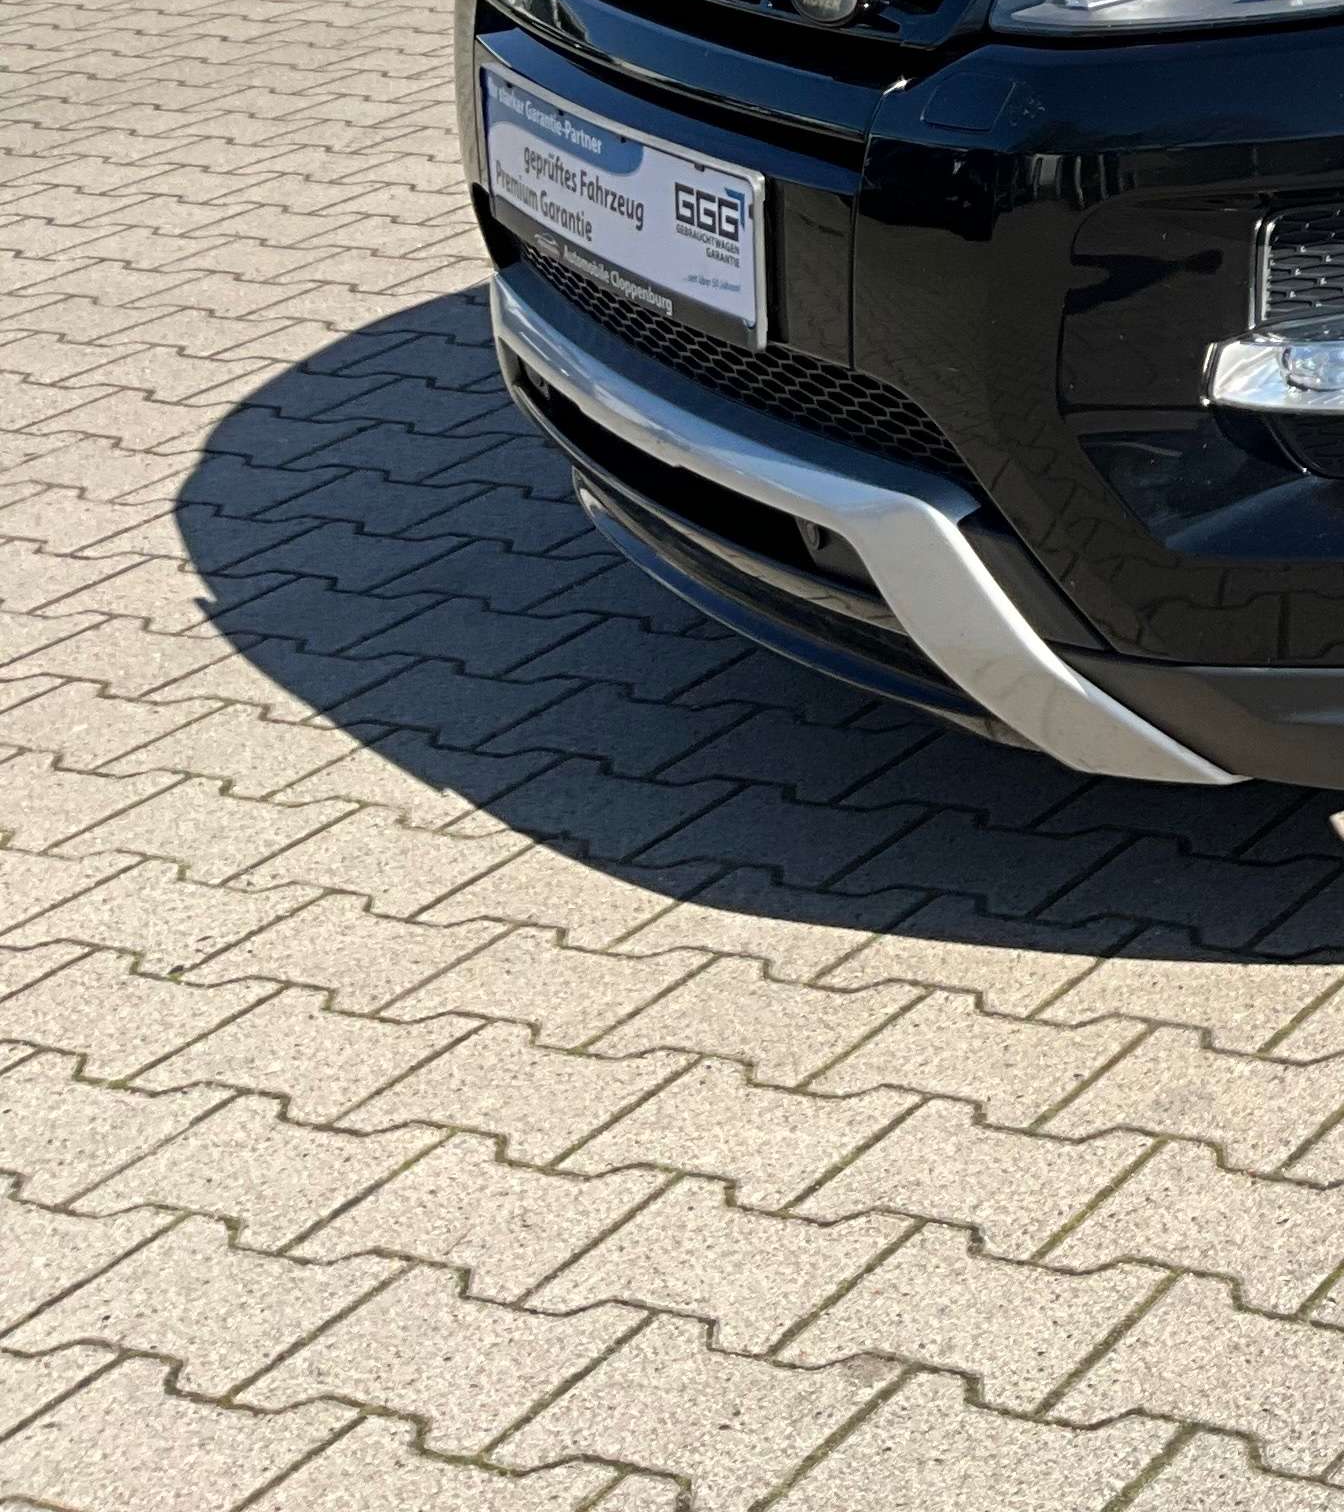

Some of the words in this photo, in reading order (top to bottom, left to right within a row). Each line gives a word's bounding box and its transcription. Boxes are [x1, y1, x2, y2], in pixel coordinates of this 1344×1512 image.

[495, 160, 538, 211] Premium
[540, 190, 592, 242] Garantie
[524, 146, 577, 193] geprüftes
[580, 169, 645, 231] Fahrzeug
[674, 181, 739, 242] GGG
